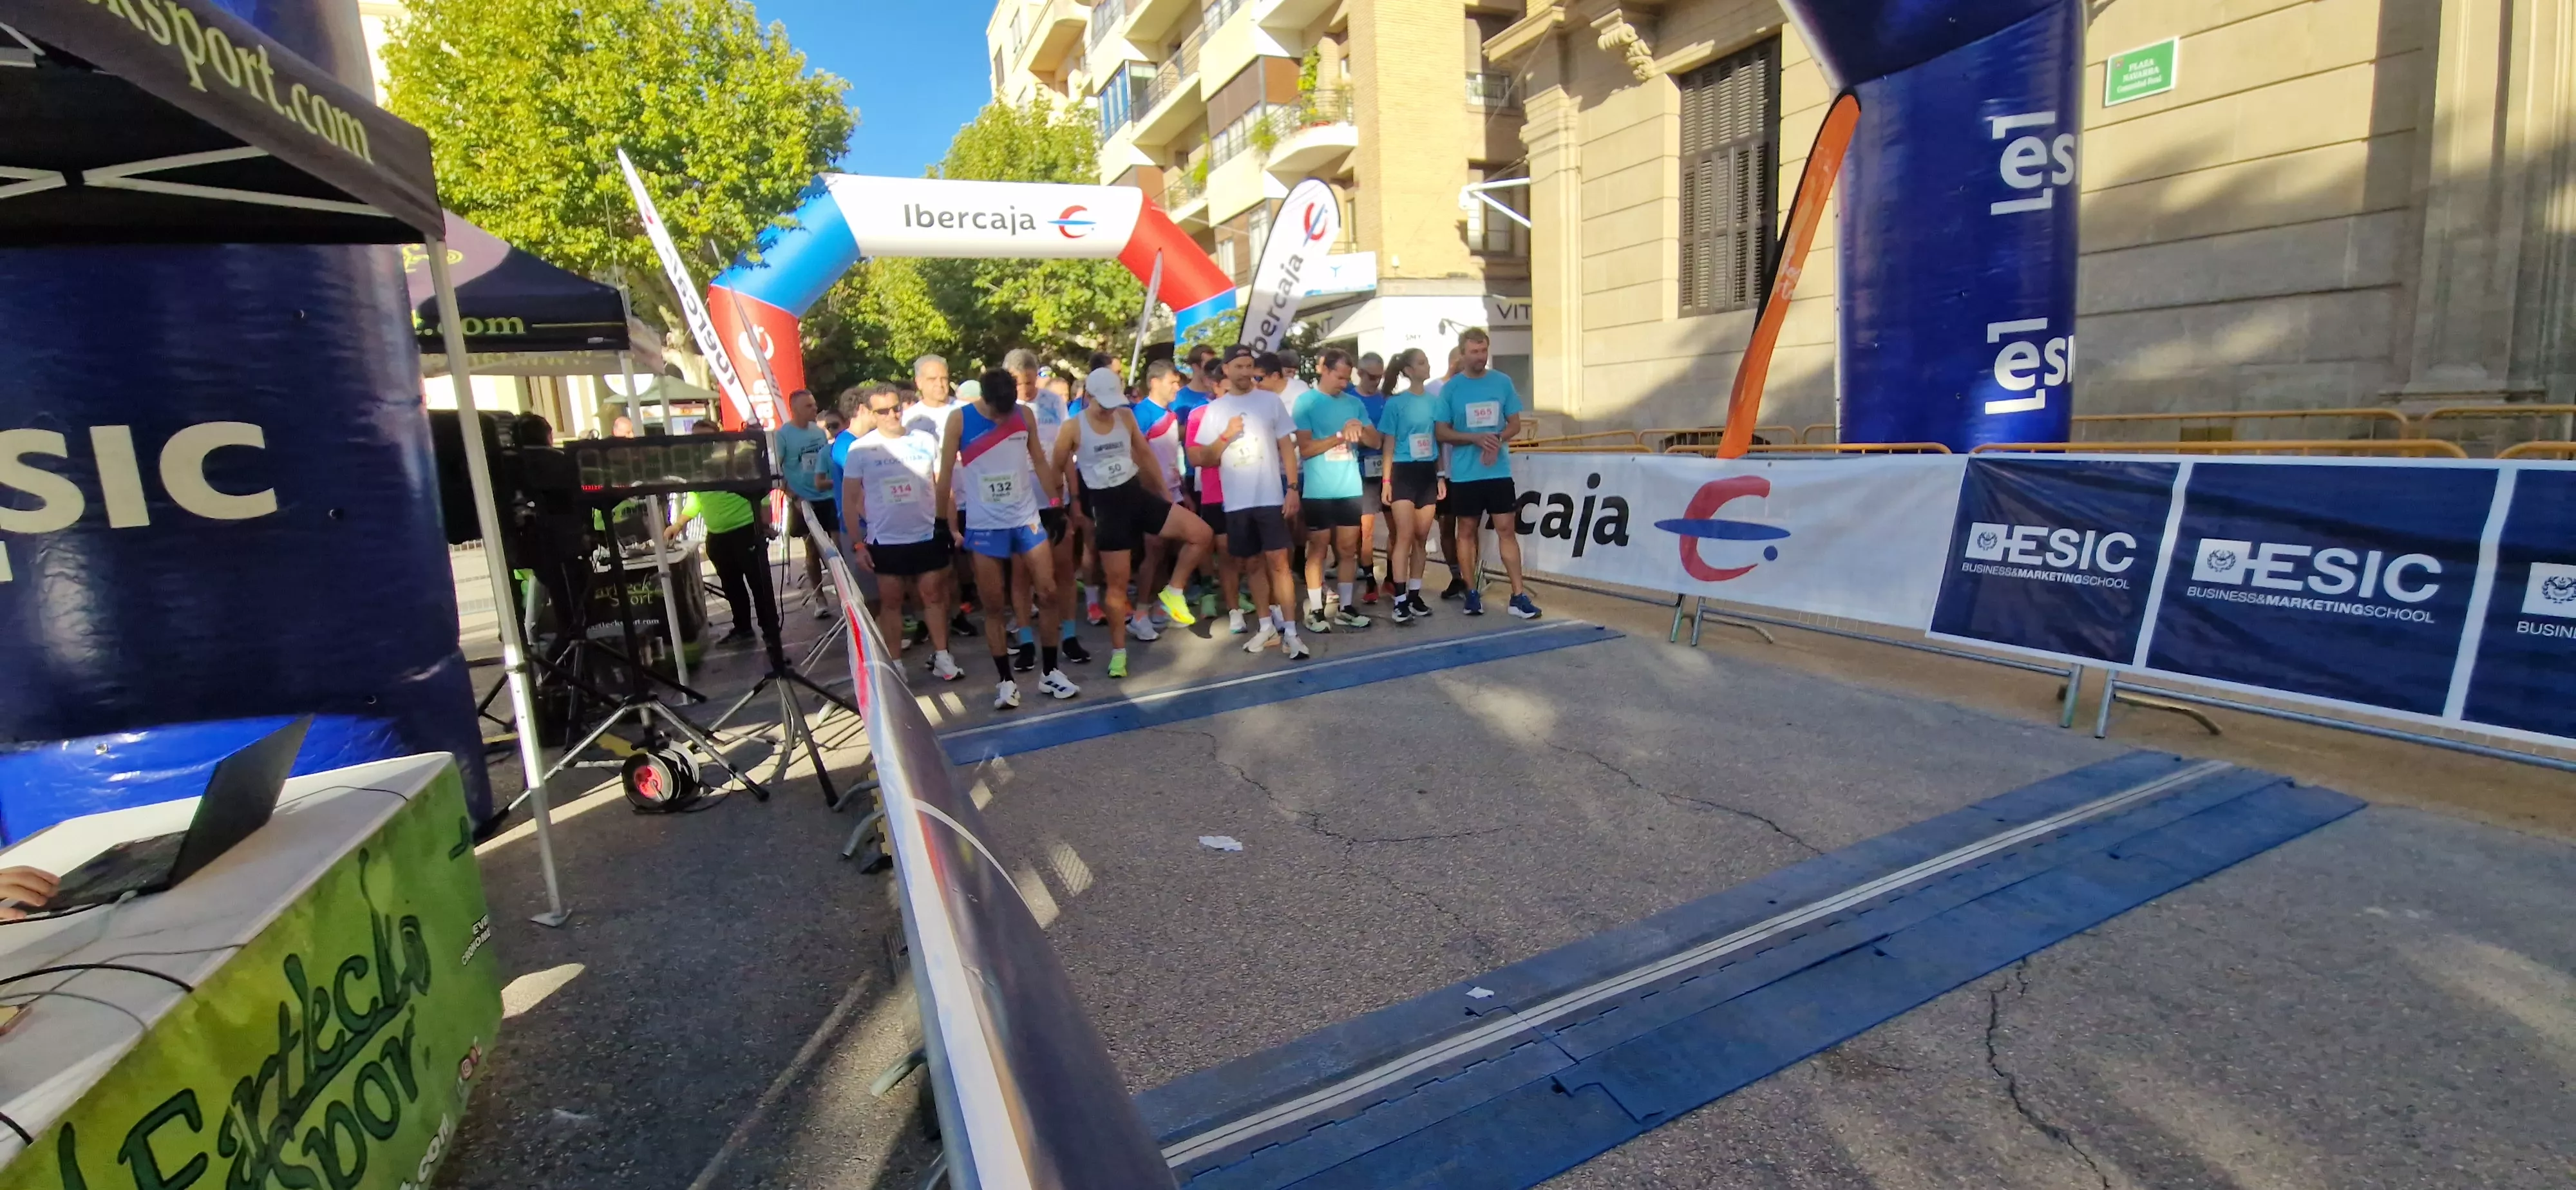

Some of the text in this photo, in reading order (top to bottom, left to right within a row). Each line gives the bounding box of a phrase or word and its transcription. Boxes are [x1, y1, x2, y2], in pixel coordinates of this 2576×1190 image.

[2128, 58, 2154, 72] PLAZA
[904, 203, 1036, 236] Ibercaja
[1247, 253, 1303, 355] bercaja
[1108, 463, 1122, 474] 50
[889, 484, 912, 494] 314
[989, 482, 1012, 493] 132
[2007, 525, 2137, 573] ESIC
[2251, 542, 2442, 603] ESIC
